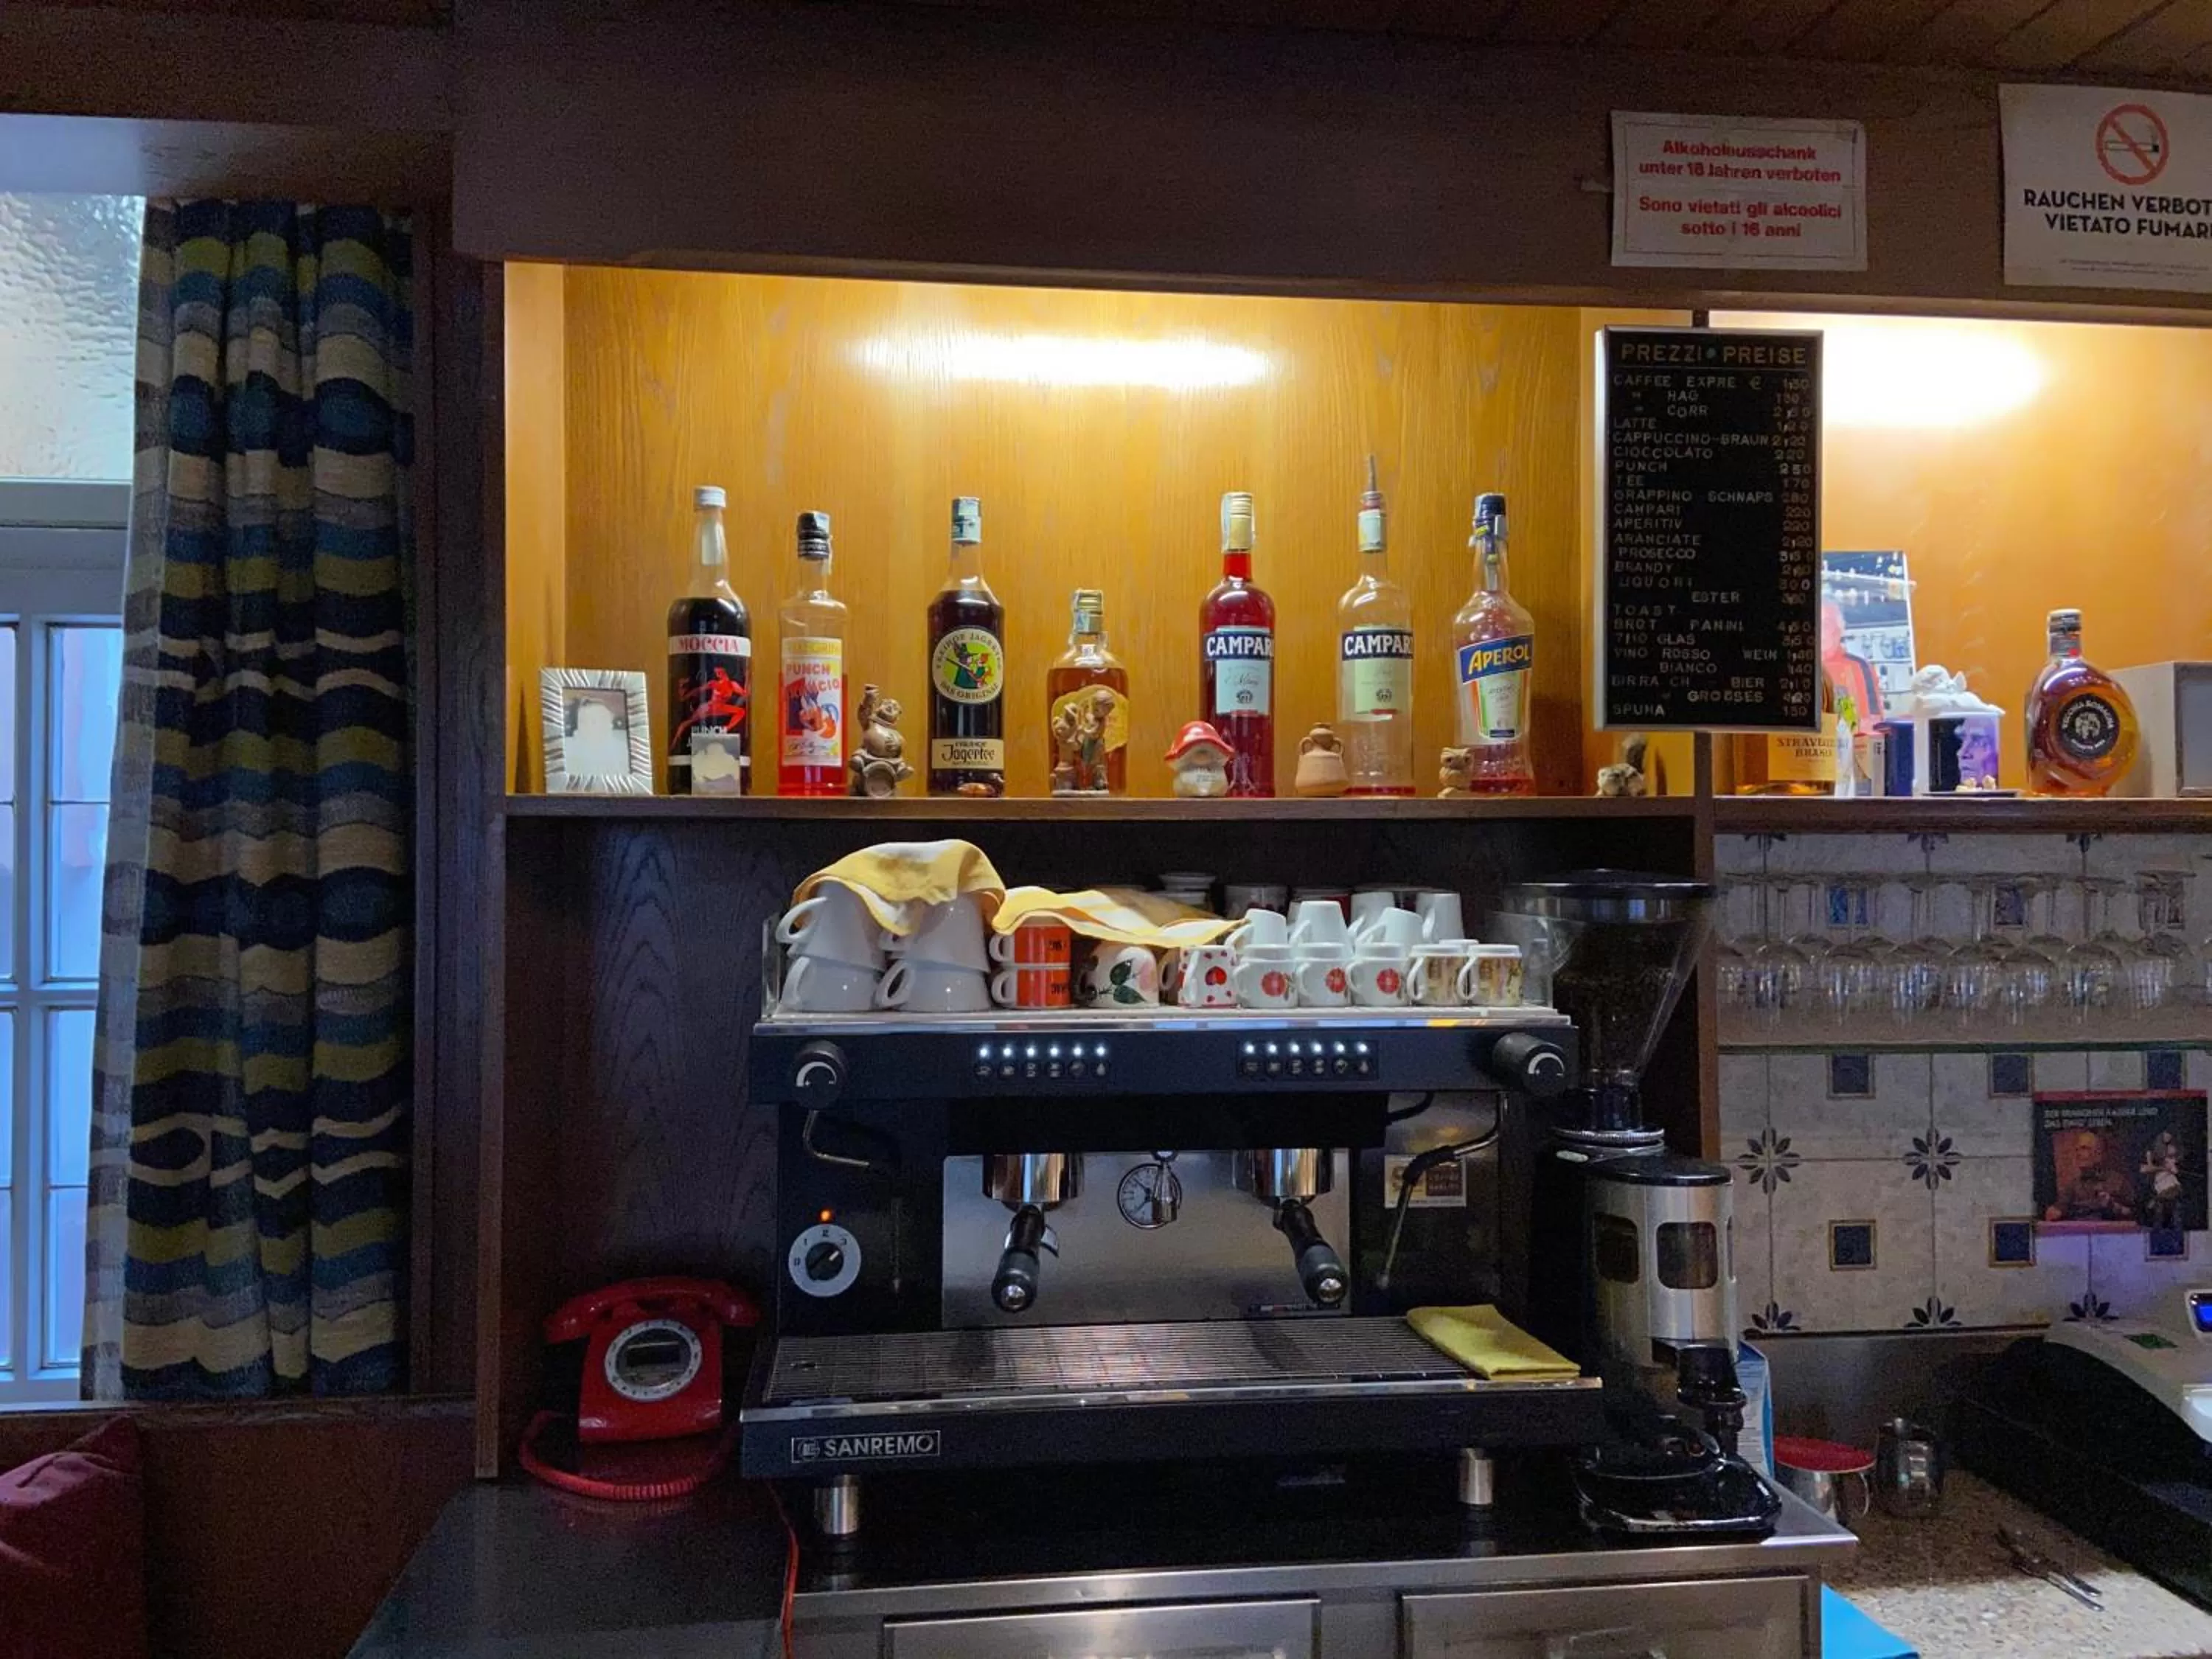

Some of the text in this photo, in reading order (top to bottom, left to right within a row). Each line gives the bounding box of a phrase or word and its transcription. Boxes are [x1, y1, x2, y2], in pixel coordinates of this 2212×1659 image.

[1639, 162, 1841, 182] unter 18 Jahren verboten
[2024, 189, 2125, 211] RAUCHEN
[1639, 196, 1842, 218] Sono vietati gli alcoolici
[1681, 223, 1725, 236] sotto
[1743, 223, 1760, 237] 16
[1765, 224, 1801, 237] anni
[2045, 214, 2130, 234] VIETATO
[1621, 344, 1806, 364] PREZZI PREISE
[1613, 417, 1657, 429] LATTE
[1613, 446, 1713, 459] CIOCCOLATO
[1615, 460, 1667, 473] PUNCH
[1613, 518, 1683, 530] APERITIV
[1614, 533, 1702, 546] ARANCIATE
[1618, 547, 1696, 560] PROSECCO
[678, 636, 741, 653] MOCCIA
[1656, 633, 1696, 646] GLAS
[1469, 644, 1530, 675] APEROL
[1662, 648, 1711, 661] ROSSO
[786, 663, 831, 675] PUNCH
[1731, 676, 1764, 689] BIER
[824, 1434, 935, 1457] SANREMO
